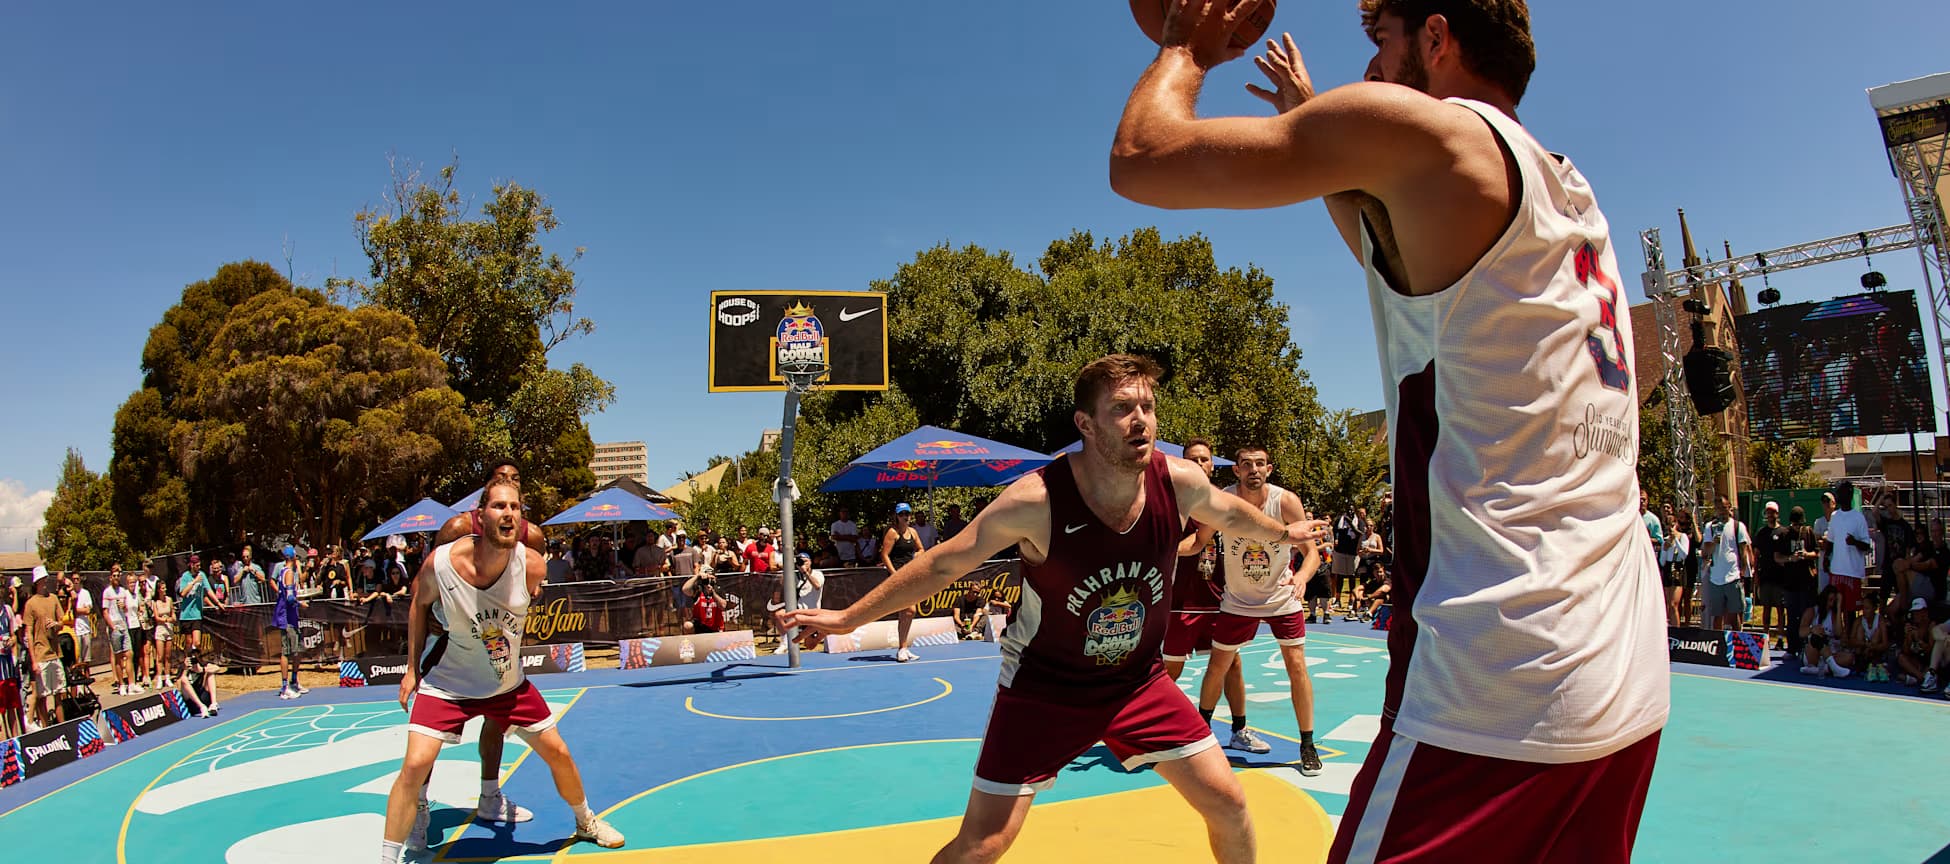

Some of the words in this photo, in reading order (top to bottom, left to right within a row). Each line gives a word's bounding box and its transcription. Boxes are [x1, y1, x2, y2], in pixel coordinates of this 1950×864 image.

[719, 298, 746, 310] HOUSE
[747, 300, 757, 309] OF
[719, 304, 760, 326] HOOPS!
[781, 332, 800, 342] Red
[801, 332, 819, 341] Bull
[779, 347, 823, 364] COURT
[1066, 561, 1142, 616] PRAHRAN
[1143, 566, 1164, 605] PARK
[536, 605, 545, 613] OF
[538, 598, 587, 640] Jam
[1092, 622, 1117, 635] Red
[1119, 617, 1140, 633] Bull
[303, 625, 324, 648] OPS!
[1668, 637, 1718, 655] PALDING
[522, 655, 546, 667] APEI
[370, 664, 408, 678] SPALDIN
[143, 703, 166, 723] MAPEI
[26, 734, 72, 764] SPALDING
